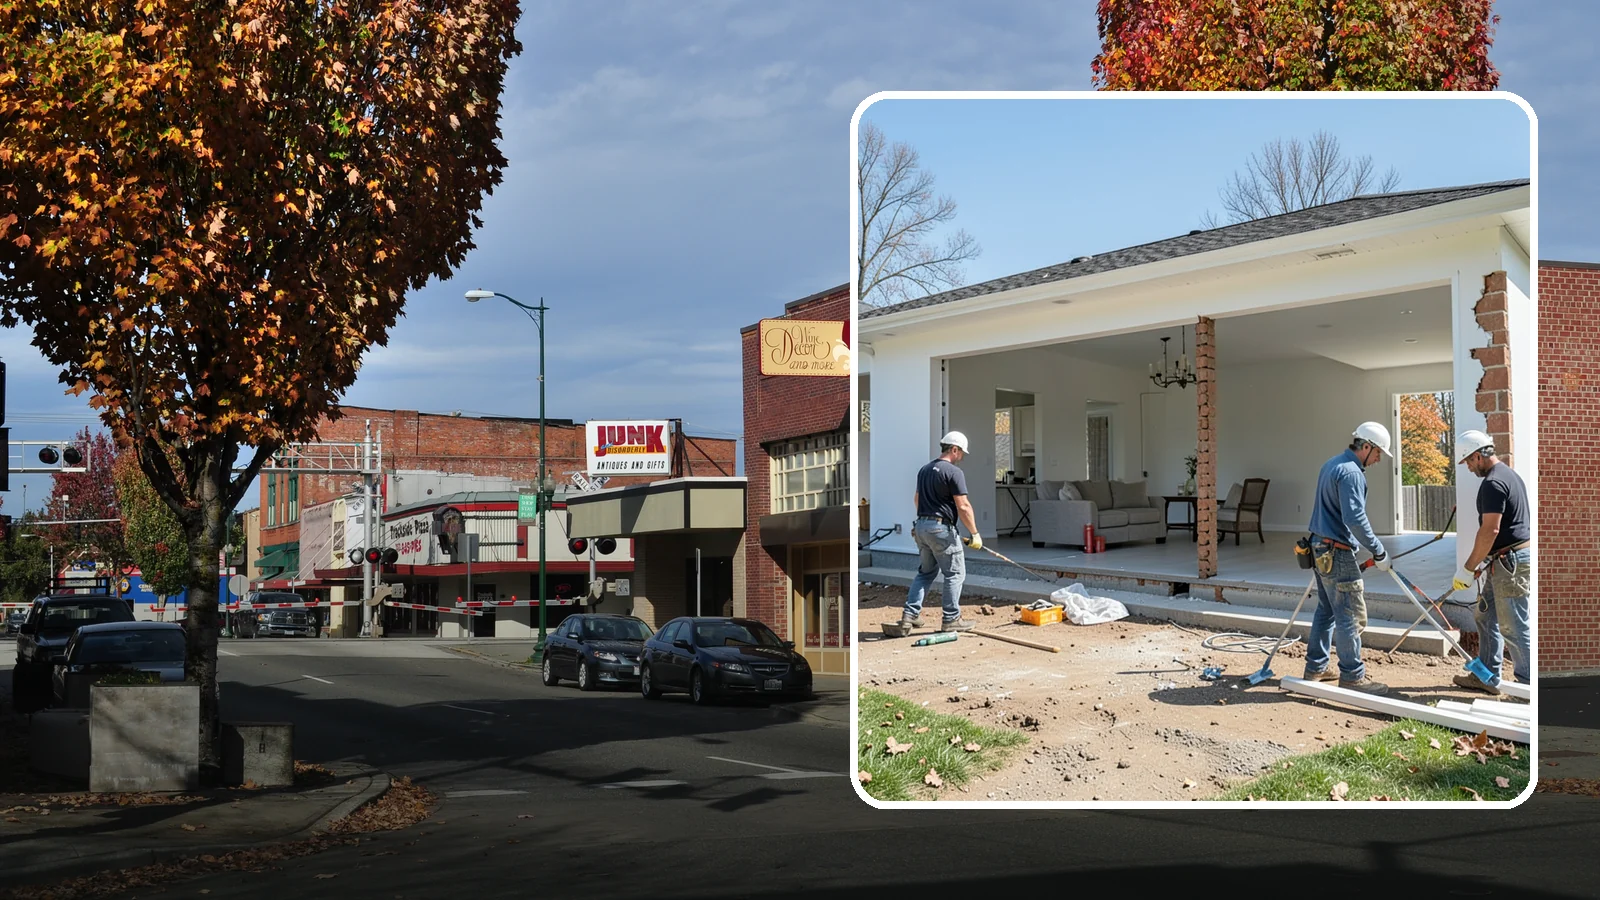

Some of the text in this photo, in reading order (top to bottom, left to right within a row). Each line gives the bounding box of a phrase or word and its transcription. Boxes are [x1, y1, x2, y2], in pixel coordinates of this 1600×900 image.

[596, 425, 665, 457] JUNK
[607, 446, 646, 454] DISORDERLY
[597, 460, 665, 470] ANTIQUES AND GIFTS
[414, 519, 429, 534] Pizza
